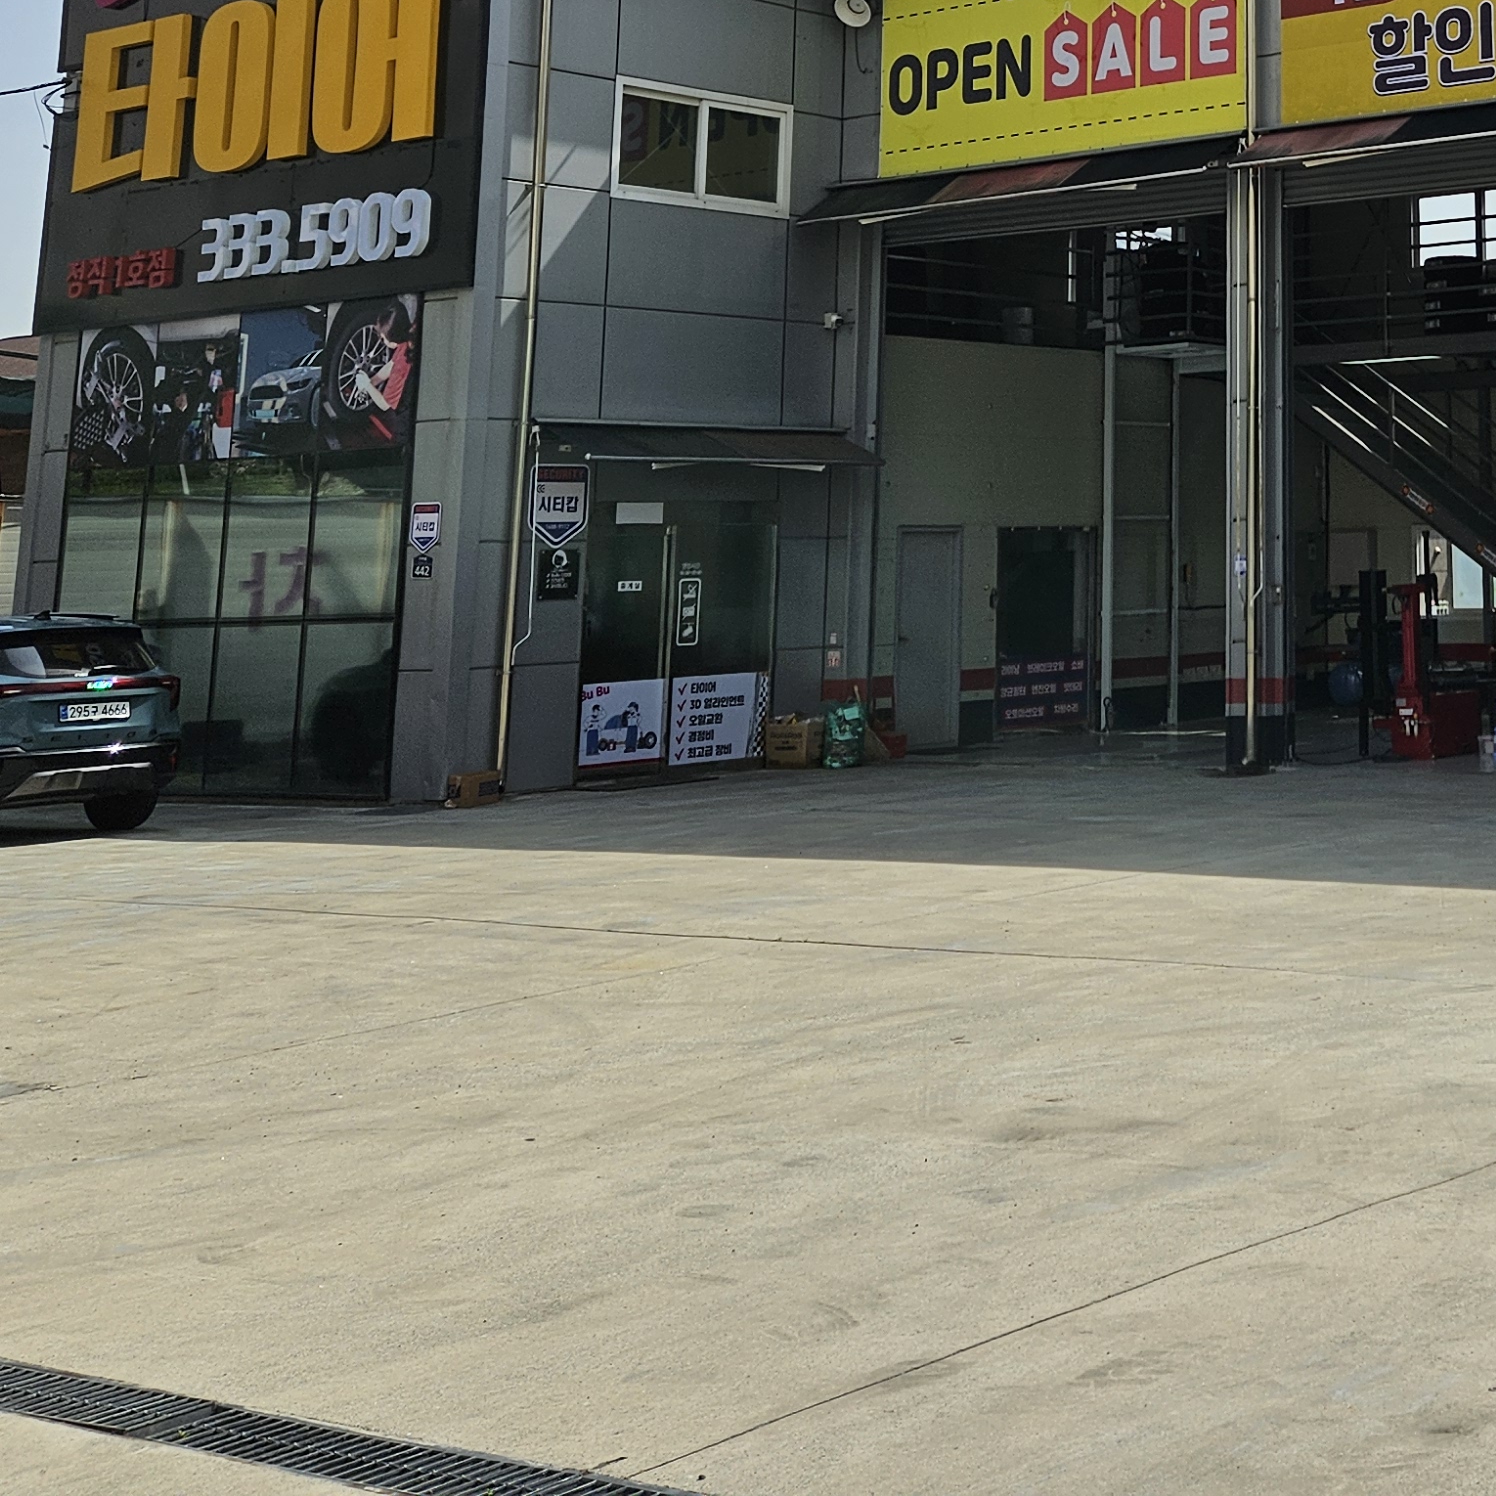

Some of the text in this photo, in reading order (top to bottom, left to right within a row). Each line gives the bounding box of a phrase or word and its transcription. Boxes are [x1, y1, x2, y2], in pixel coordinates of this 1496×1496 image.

[889, 5, 1229, 116] OPEN SALE
[197, 188, 432, 282] 333.5909
[414, 565, 431, 577] 442
[690, 681, 717, 694] 타이어
[101, 703, 128, 716] 4666
[689, 699, 702, 710] 3D
